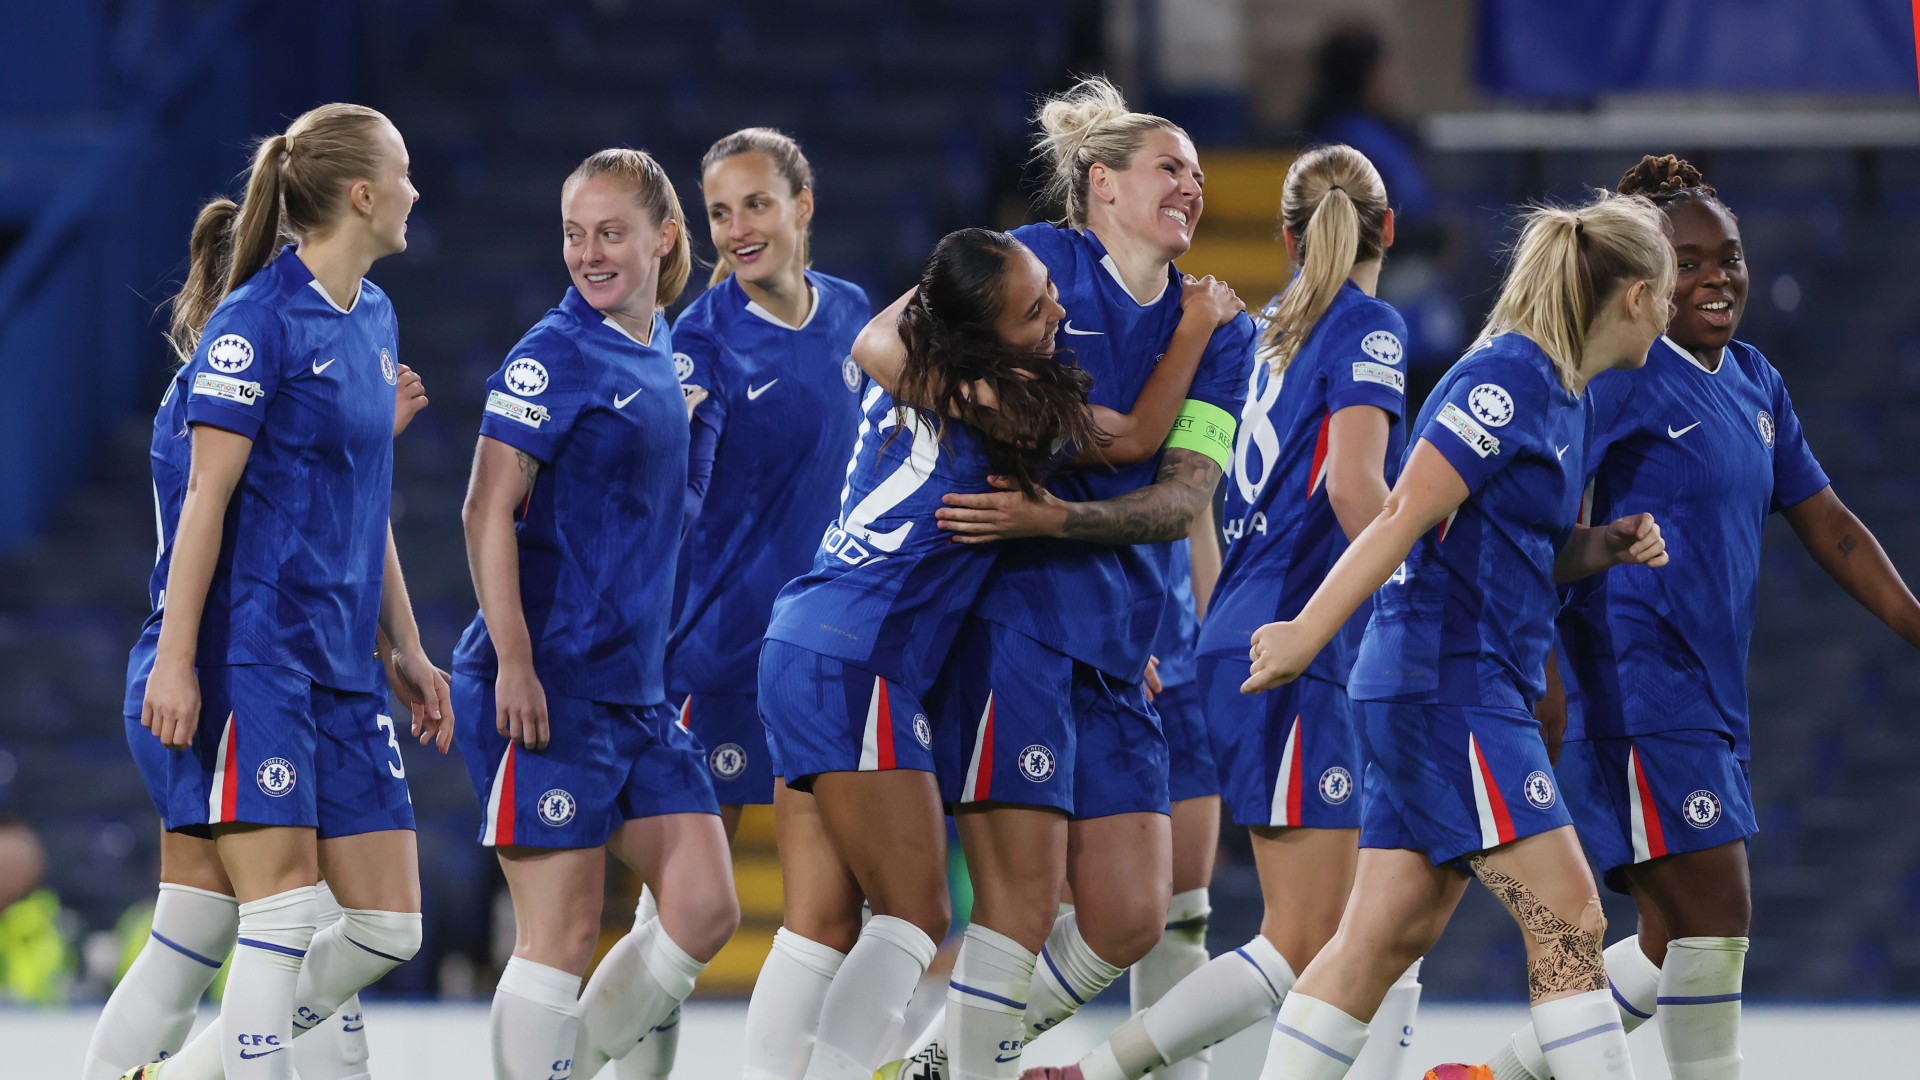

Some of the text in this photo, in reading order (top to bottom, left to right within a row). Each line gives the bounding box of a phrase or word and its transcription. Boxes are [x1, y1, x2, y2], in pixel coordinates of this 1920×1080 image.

[196, 380, 236, 393] FOUNDATION
[1173, 418, 1195, 429] ECT
[376, 713, 405, 779] 3
[263, 758, 290, 768] CHELSEA
[1687, 791, 1711, 803] CHELSEA
[238, 1033, 280, 1046] CFC
